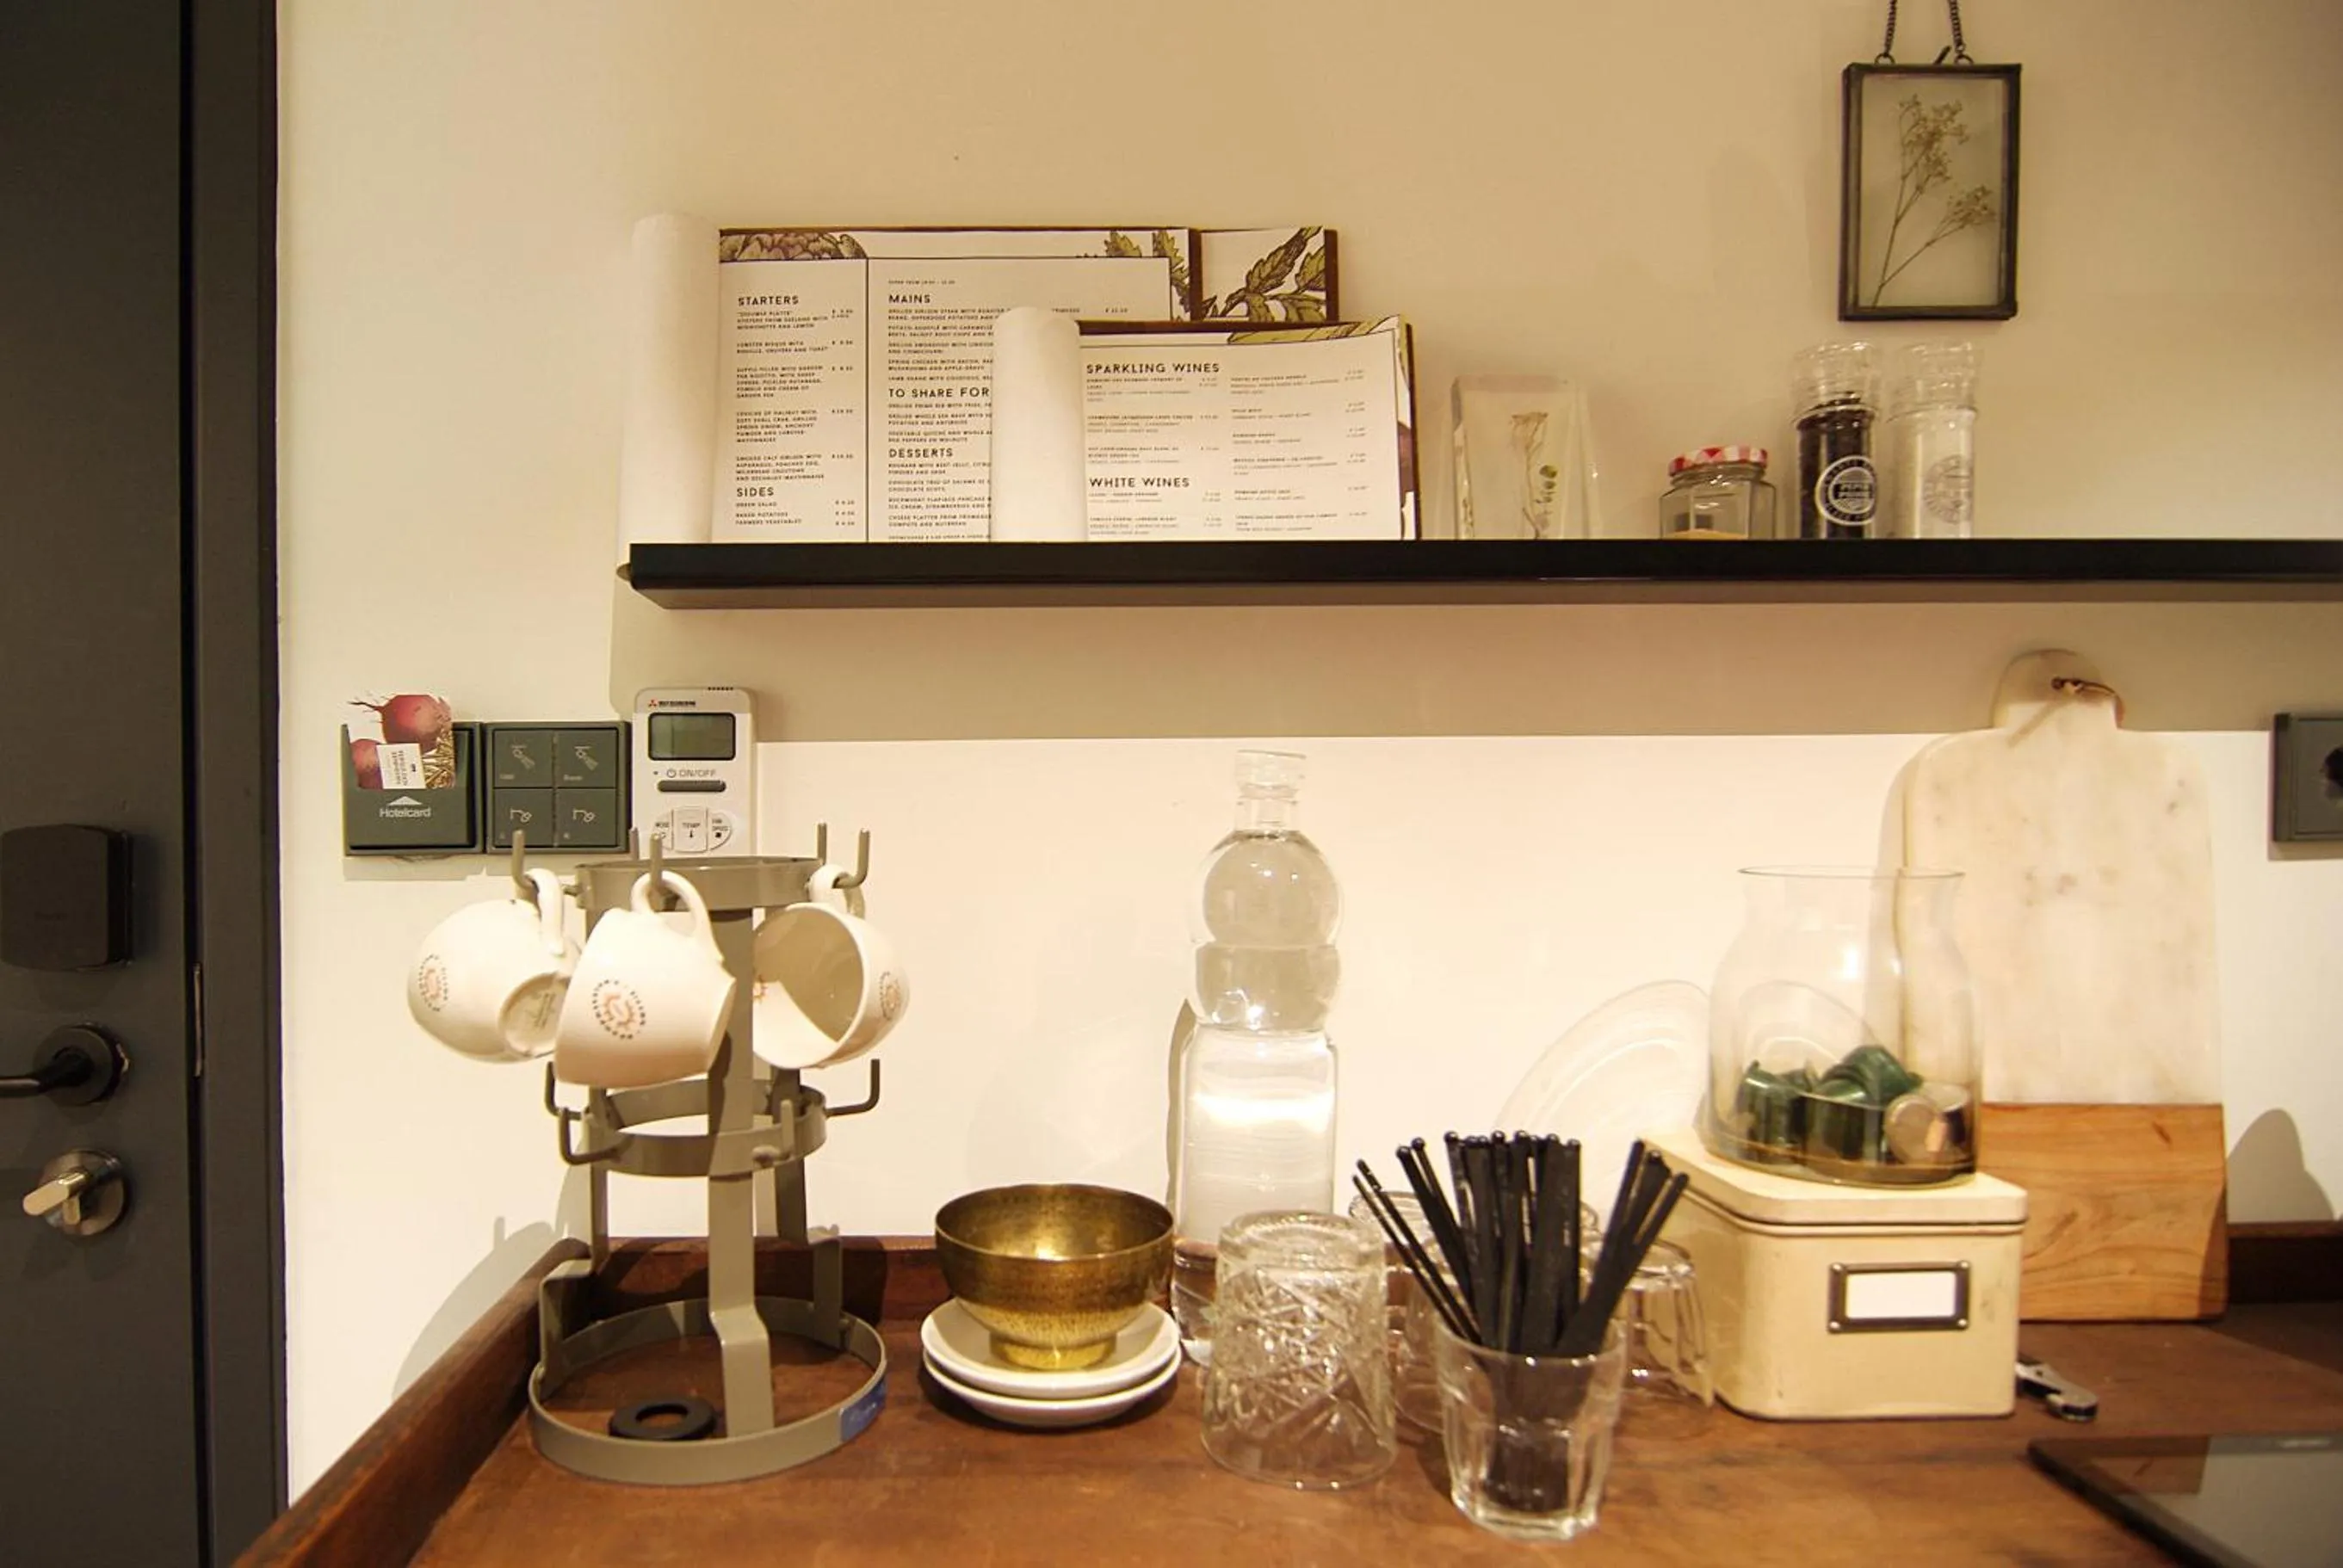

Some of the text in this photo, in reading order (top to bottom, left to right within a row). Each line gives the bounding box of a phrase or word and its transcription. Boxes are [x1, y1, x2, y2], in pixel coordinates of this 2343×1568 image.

[739, 295, 799, 306] STARTERS
[888, 294, 930, 304] MAINS
[1086, 362, 1220, 374] SPARKLING WINES
[889, 387, 990, 398] TO SHARE FOR
[888, 448, 953, 459] DESSERTS
[1090, 477, 1190, 488] WHITE WINES
[737, 487, 774, 497] SIDES
[679, 769, 716, 777] ON/OFF
[380, 807, 431, 818] Hotelcard
